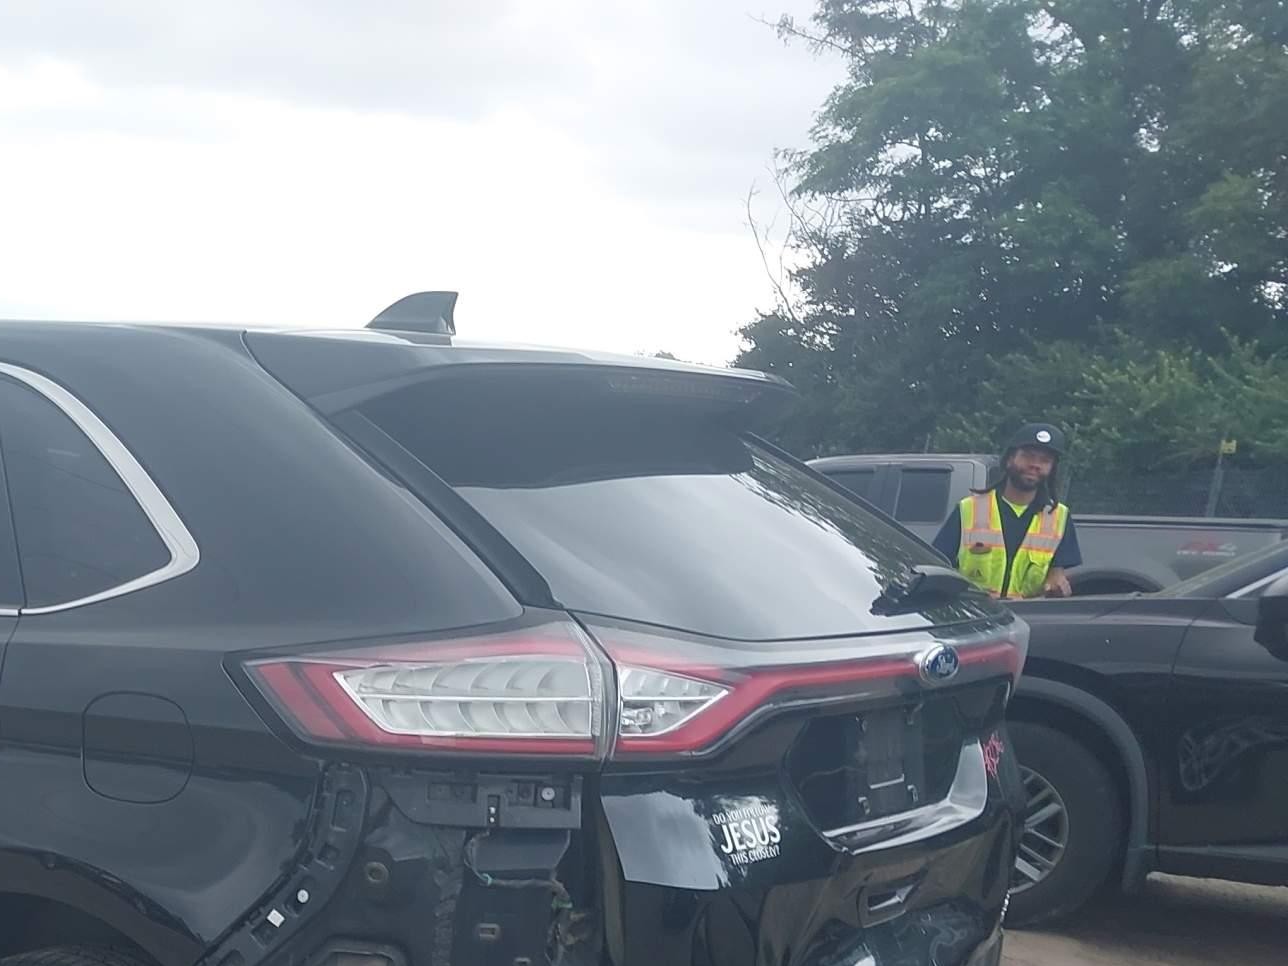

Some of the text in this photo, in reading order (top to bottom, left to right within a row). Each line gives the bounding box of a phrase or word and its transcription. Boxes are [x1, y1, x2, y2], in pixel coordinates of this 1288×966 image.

[712, 812, 726, 825] DO
[726, 807, 743, 822] YOU
[720, 815, 781, 854] JESUS
[729, 850, 749, 866] THIS
